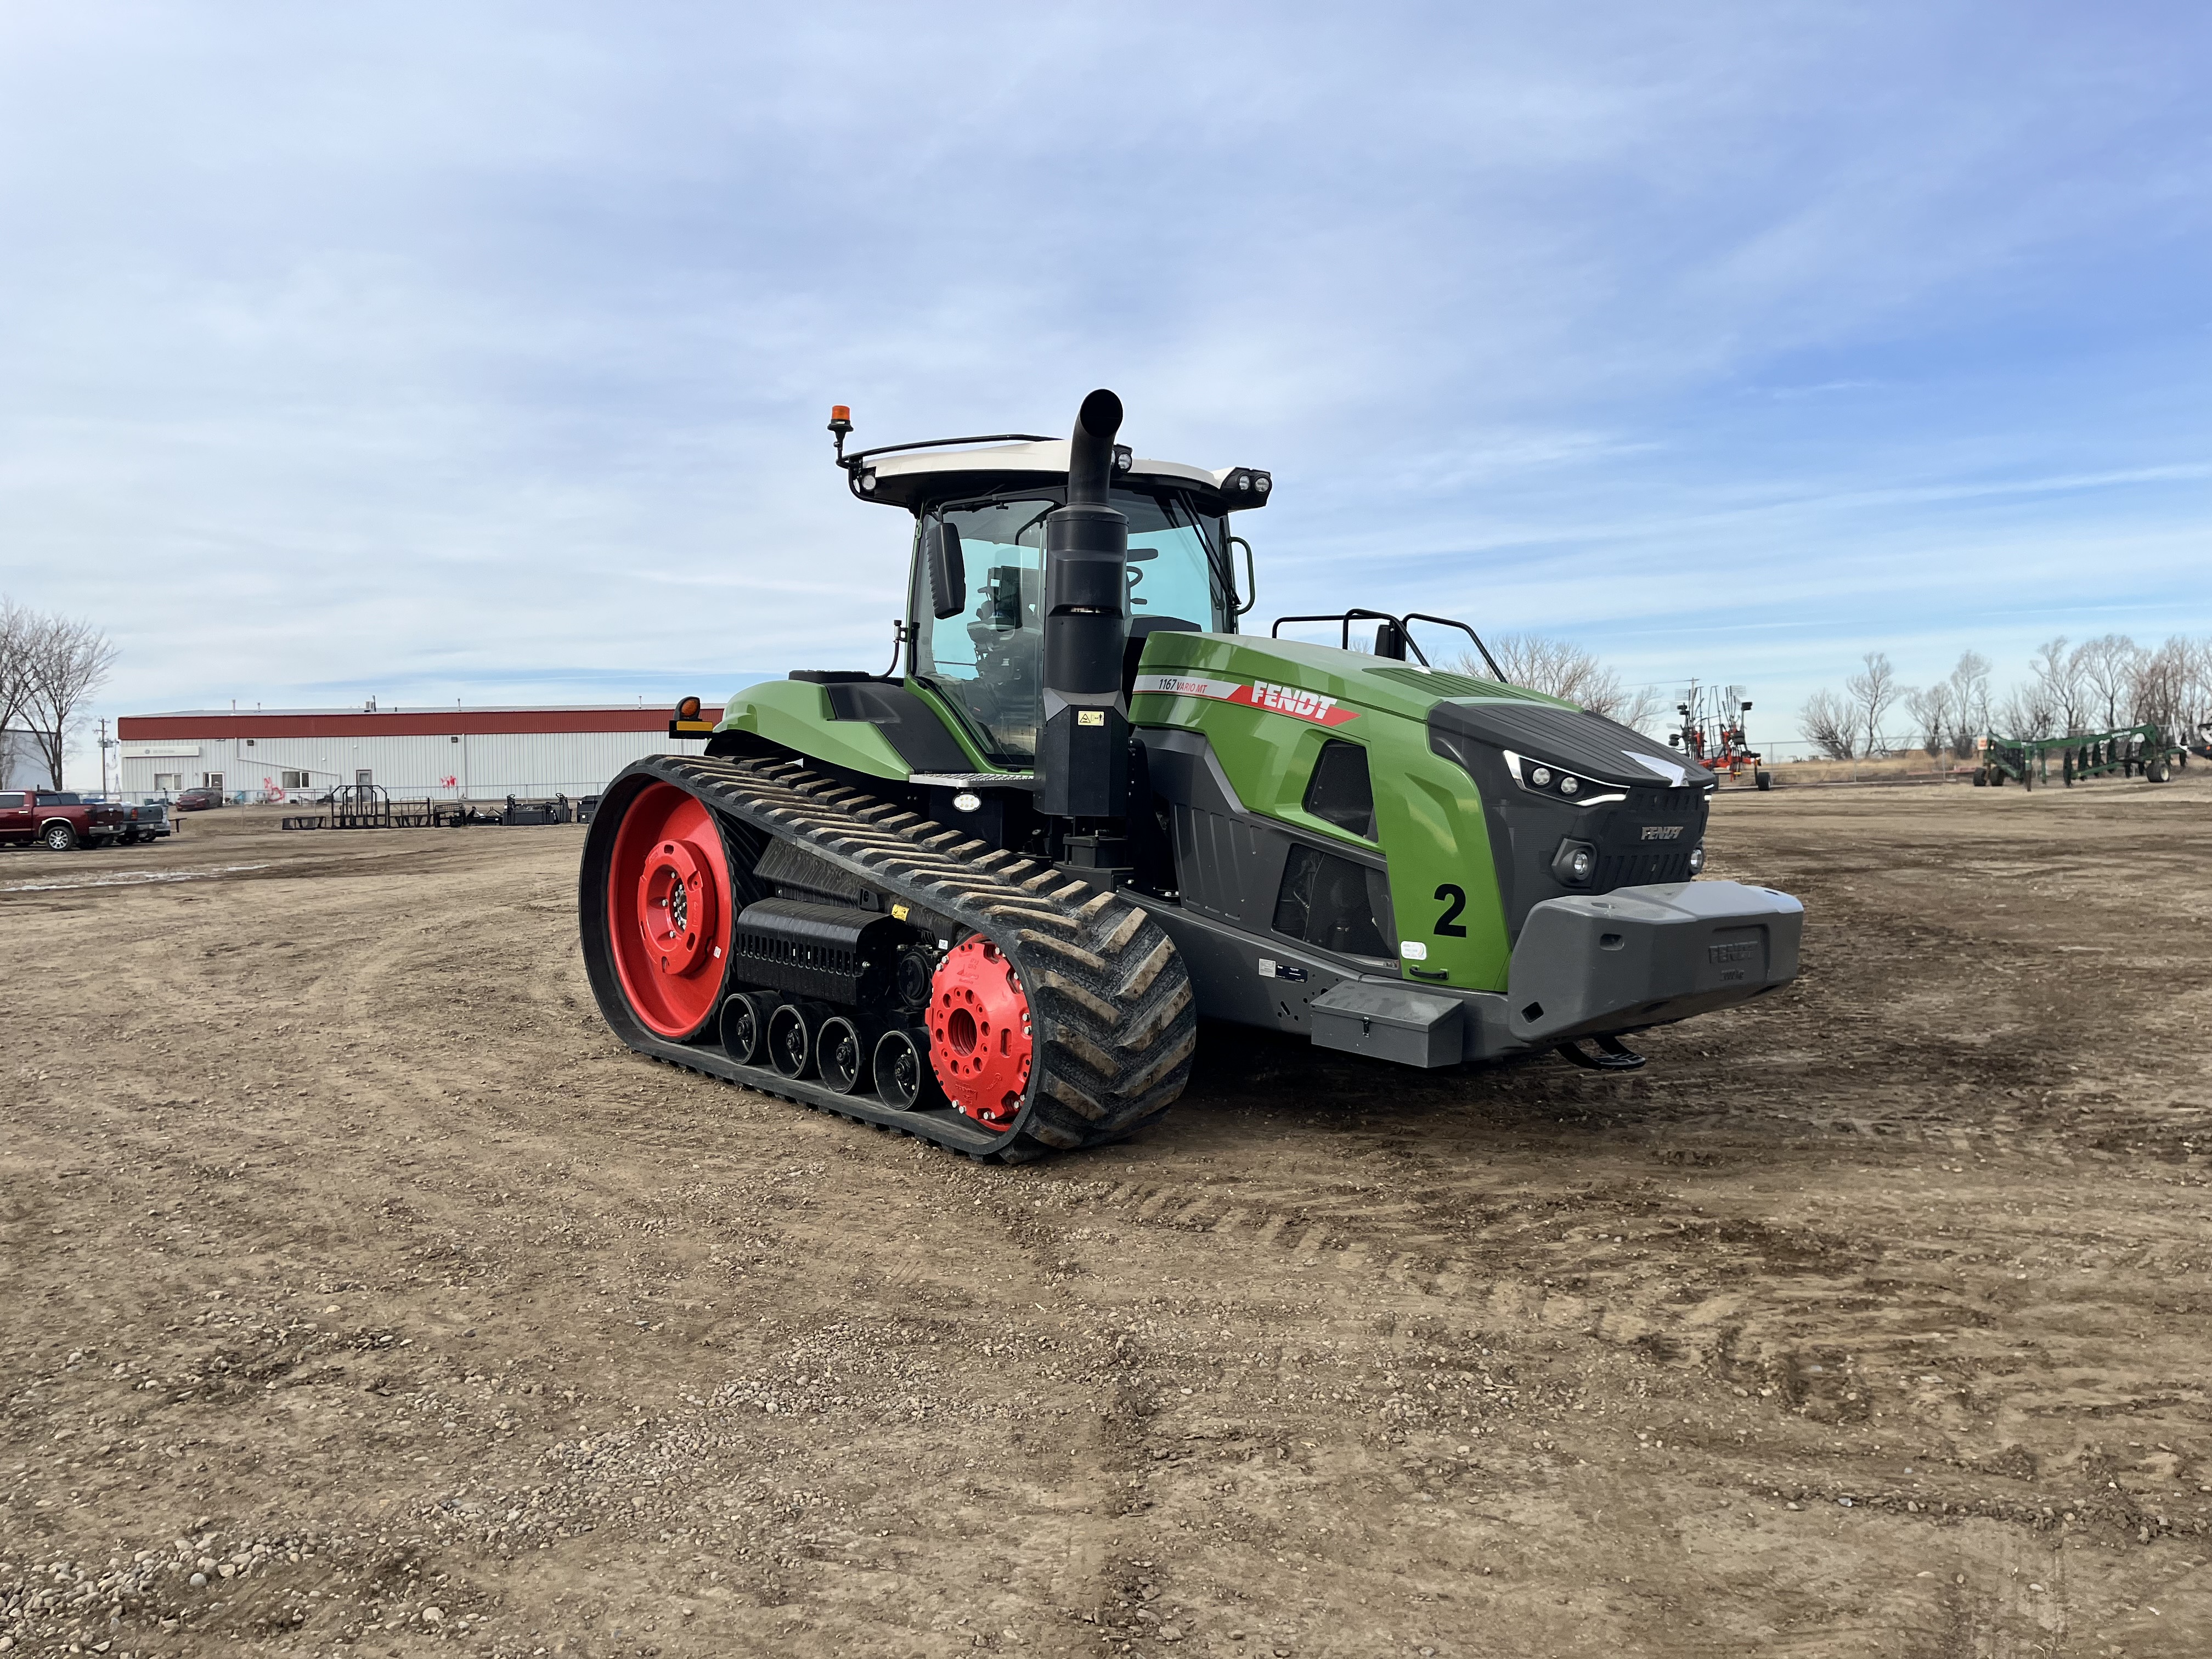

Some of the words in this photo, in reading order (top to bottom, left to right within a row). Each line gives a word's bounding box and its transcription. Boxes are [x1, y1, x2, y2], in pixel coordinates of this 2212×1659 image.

[1159, 679, 1177, 690] 1167
[1176, 681, 1195, 692] VARIO
[1195, 684, 1207, 694] MT
[1251, 680, 1338, 720] FENDT
[1640, 826, 1684, 840] FENDT
[1433, 883, 1466, 938] 2
